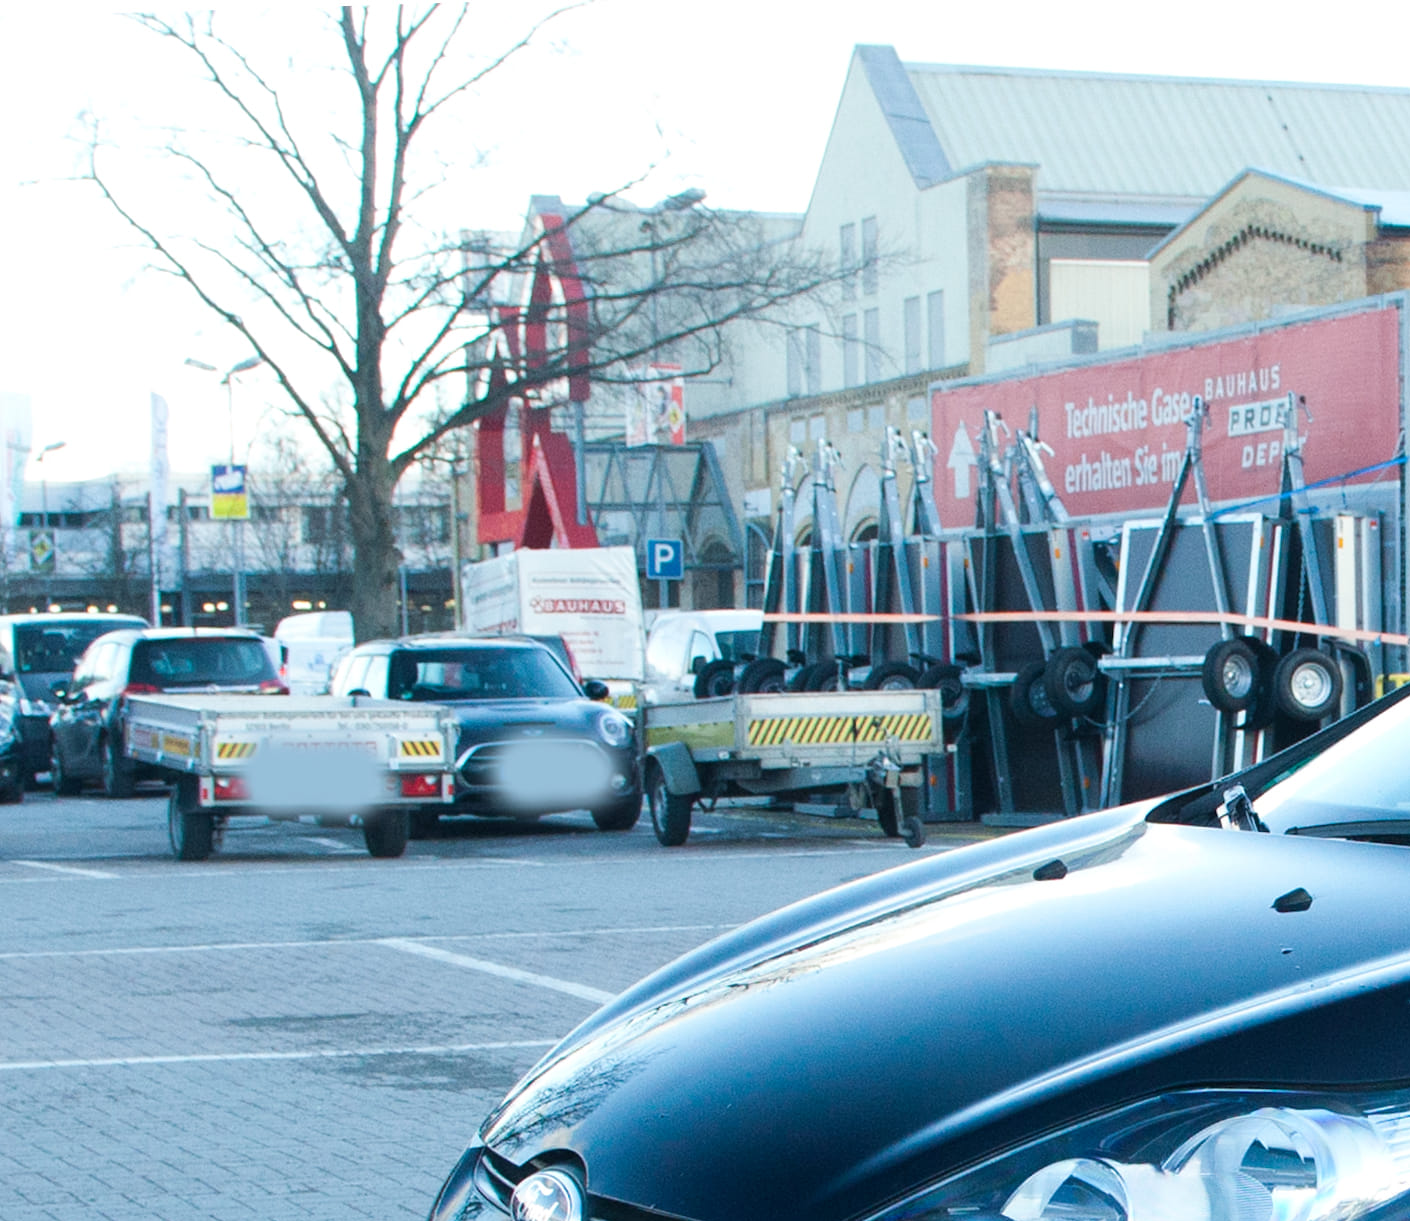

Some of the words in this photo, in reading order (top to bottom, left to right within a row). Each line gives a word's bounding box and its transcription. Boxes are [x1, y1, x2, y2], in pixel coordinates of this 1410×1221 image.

[1204, 364, 1281, 400] BAUHAUS
[1065, 392, 1148, 439] Technische
[1151, 387, 1194, 426] Gase
[1065, 450, 1132, 494] erhalten
[1134, 446, 1158, 485] Sie
[654, 543, 675, 574] P
[543, 600, 626, 614] BAUHAUS
